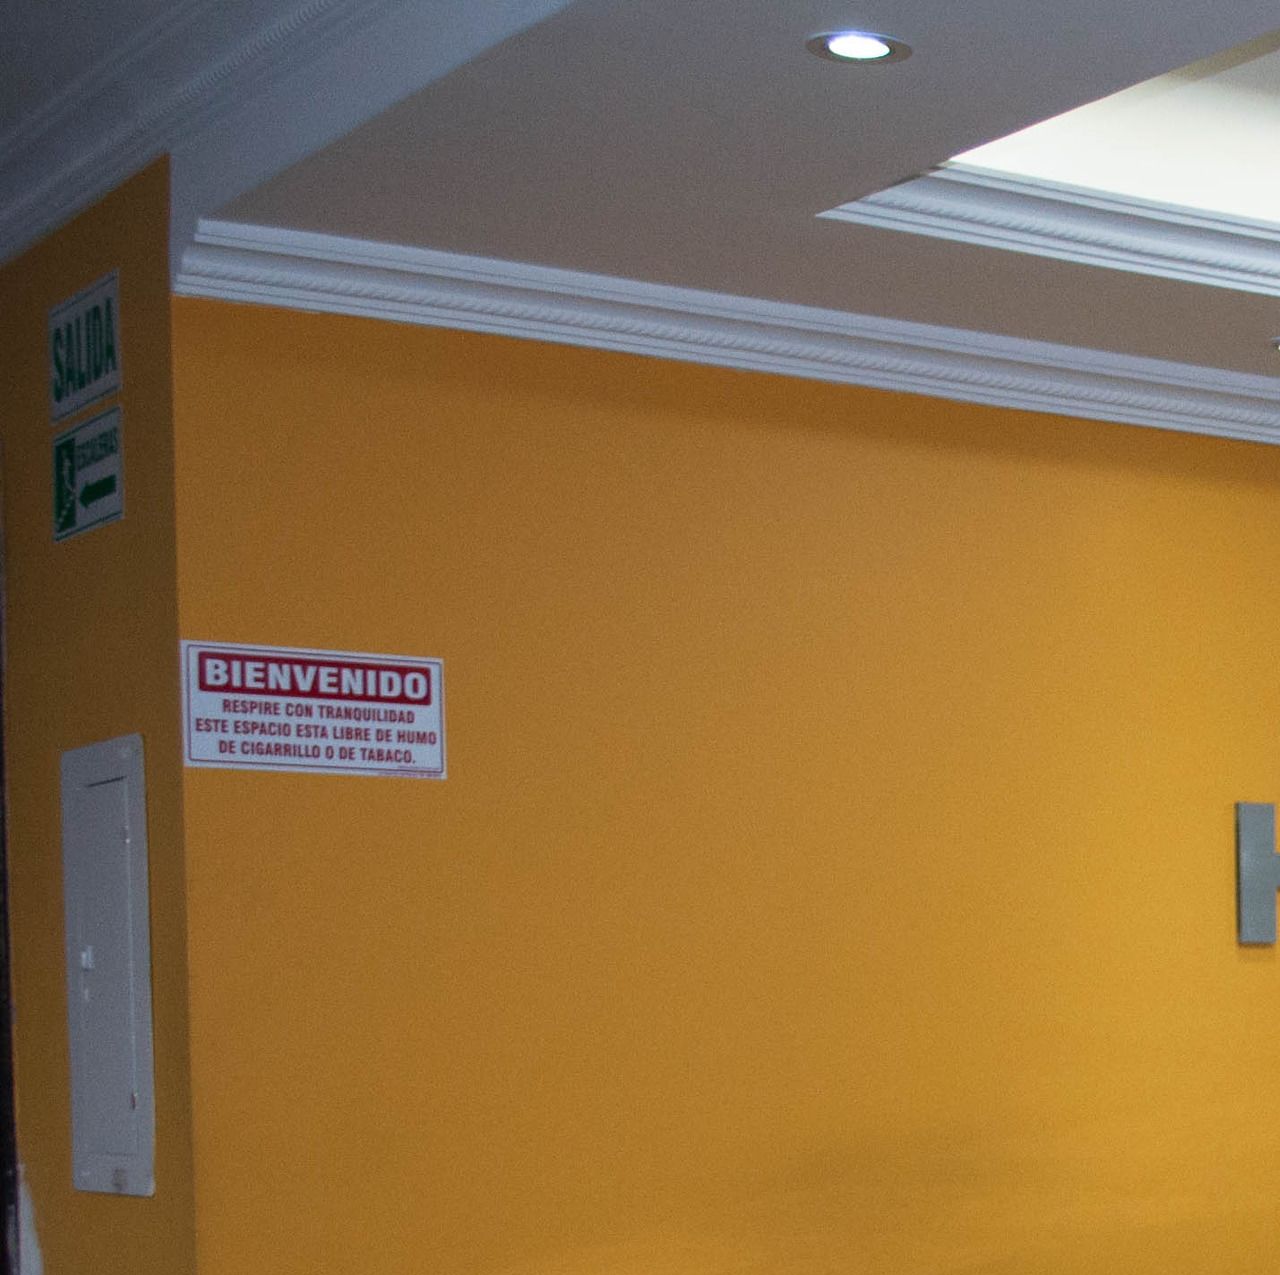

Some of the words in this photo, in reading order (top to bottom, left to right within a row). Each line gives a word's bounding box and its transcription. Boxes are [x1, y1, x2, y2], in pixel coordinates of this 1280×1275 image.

[54, 297, 118, 403] SALIDA
[205, 658, 428, 699] BIENVENIDO
[222, 699, 281, 716] RESPIRE
[285, 704, 314, 718] CON
[318, 705, 415, 724] TRANQUILIDAD
[195, 718, 229, 733] ESTE
[234, 720, 292, 737] ESPACIO
[296, 723, 329, 739] ESTA
[333, 725, 371, 741] LIBRE
[376, 729, 392, 743] DE
[397, 729, 437, 745] HUMO
[219, 740, 236, 754] DE
[241, 741, 321, 759] CIGARRILLO
[325, 745, 334, 760] O
[339, 746, 356, 760] DE
[361, 748, 416, 764] TABACO.
